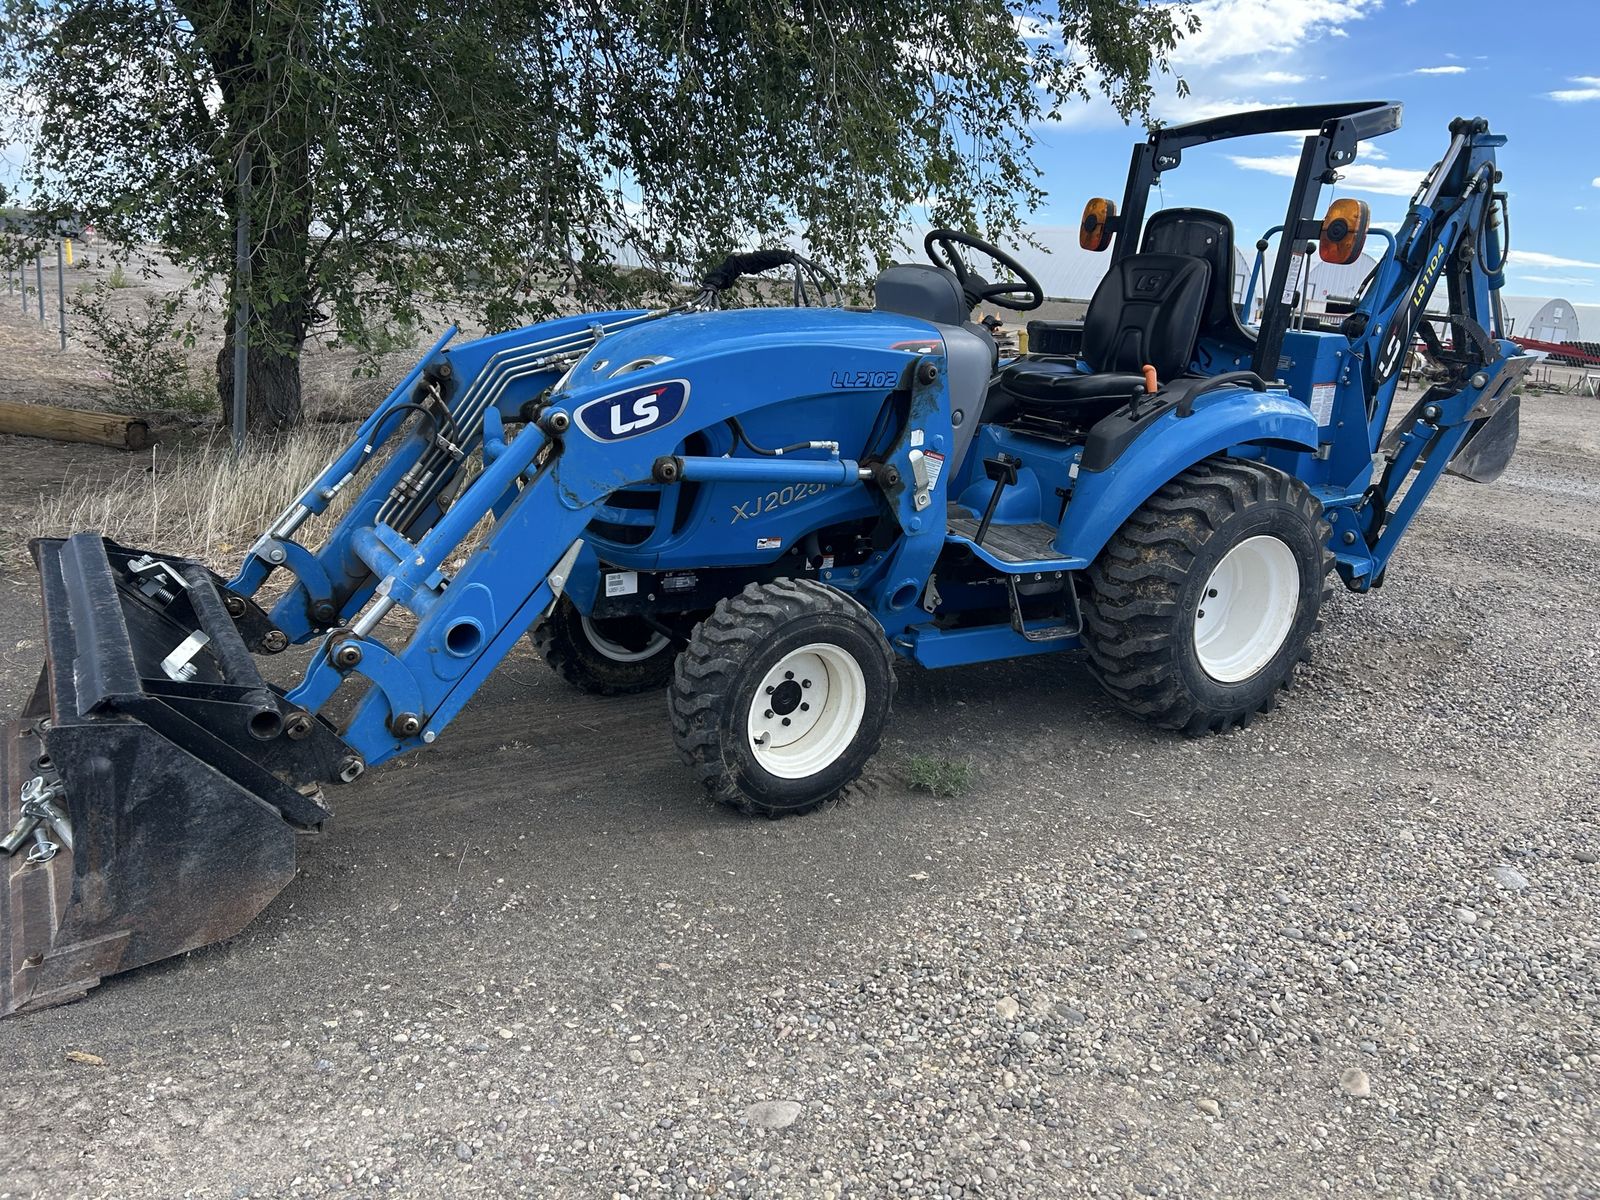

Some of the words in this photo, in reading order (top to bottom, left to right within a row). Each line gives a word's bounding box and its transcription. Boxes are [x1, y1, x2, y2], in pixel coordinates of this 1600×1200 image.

[1135, 274, 1163, 291] LS
[1412, 242, 1445, 308] LB1104
[831, 371, 899, 389] LL2102
[610, 393, 660, 435] LS
[730, 483, 833, 525] XJ2025
